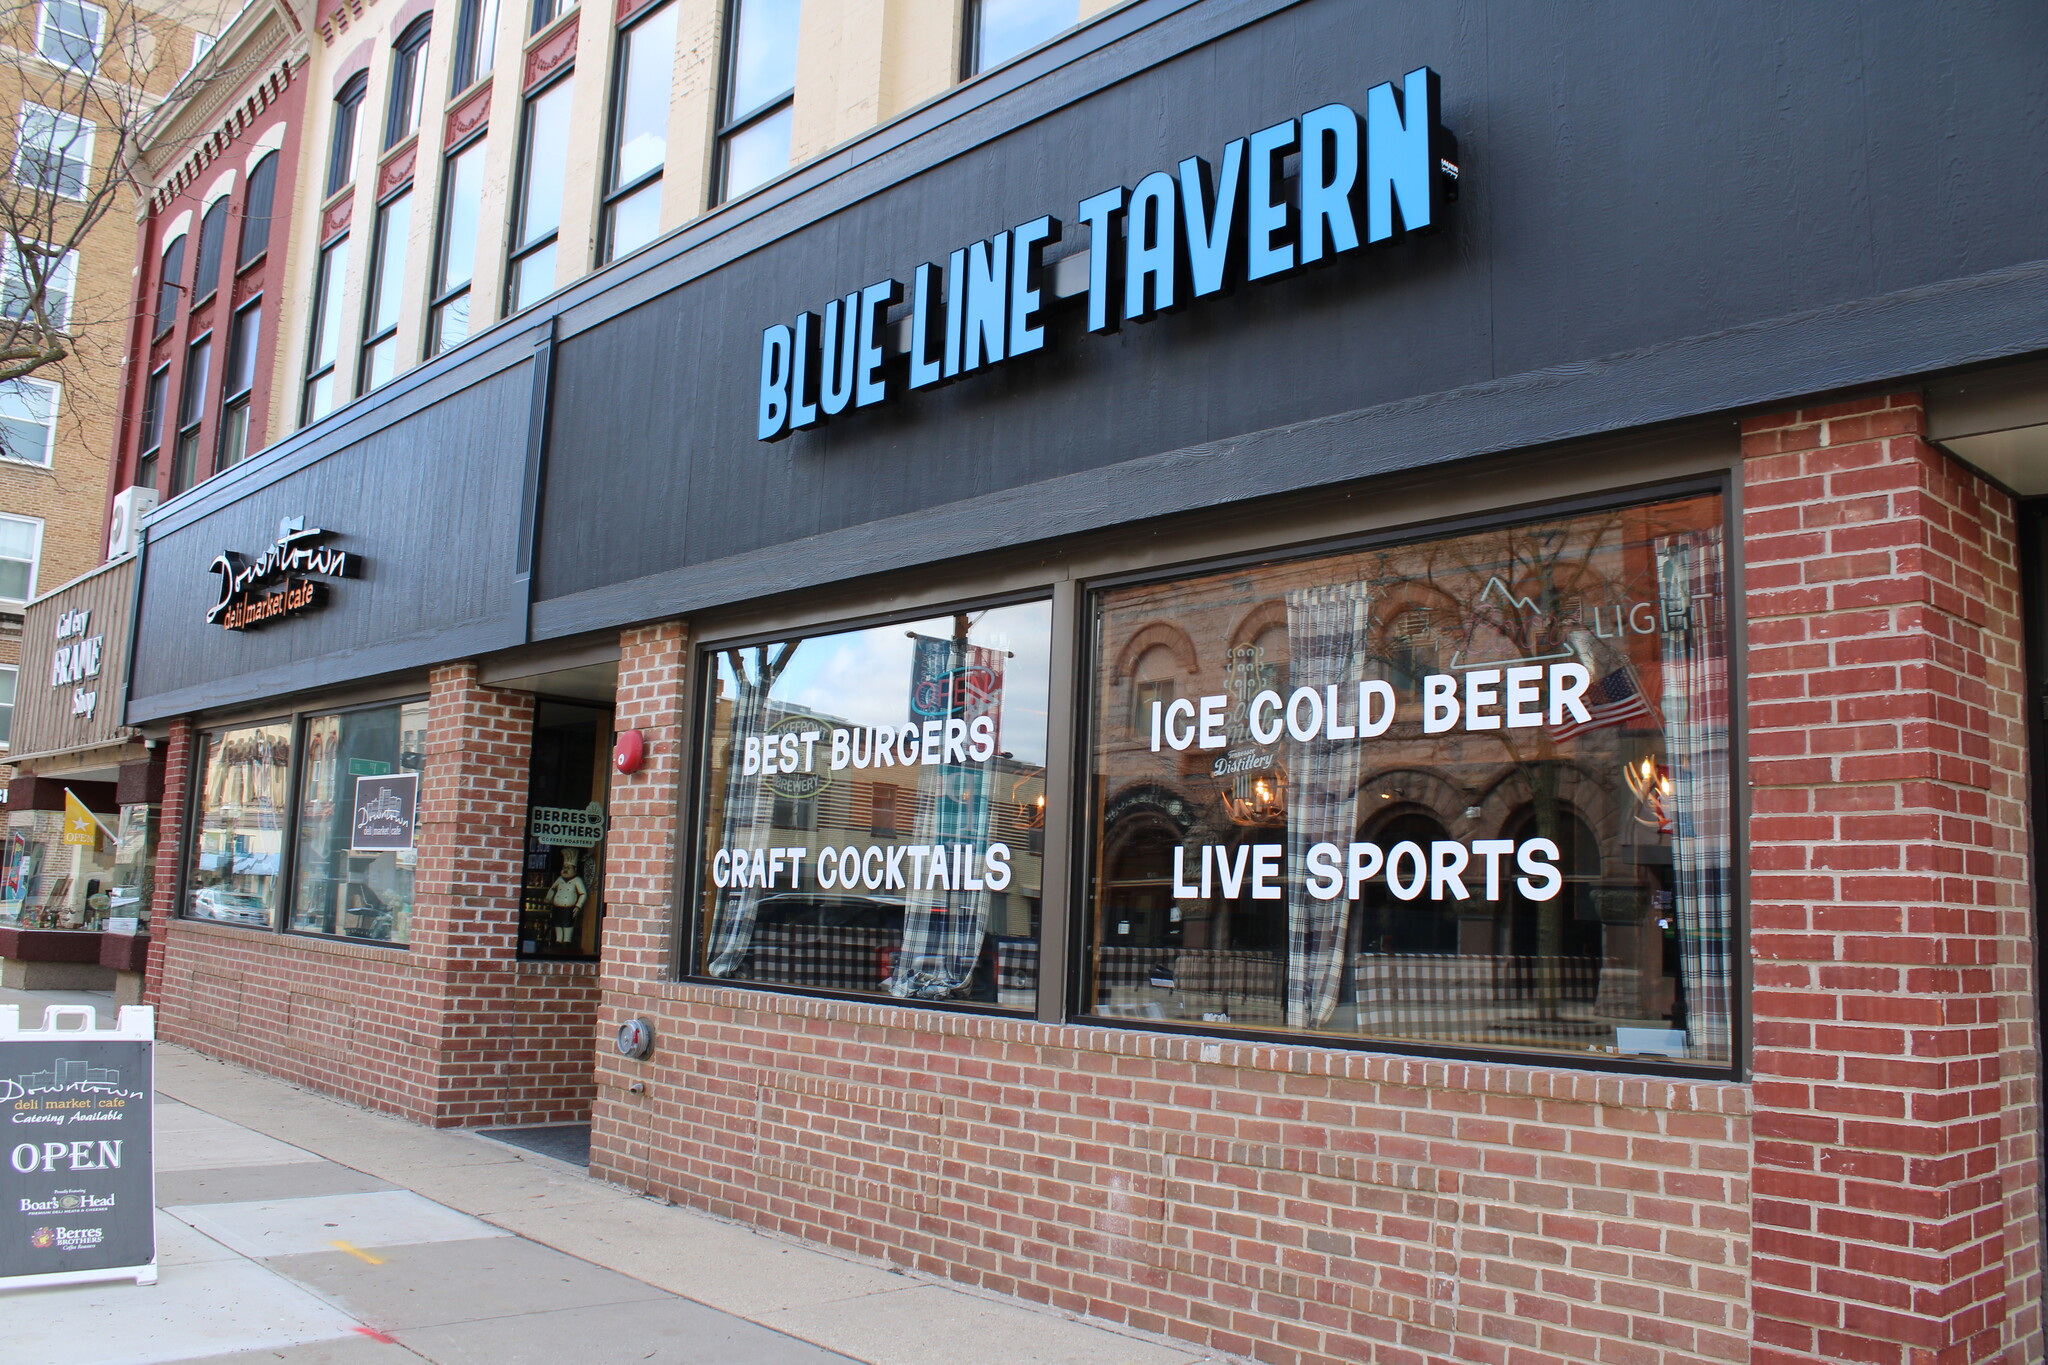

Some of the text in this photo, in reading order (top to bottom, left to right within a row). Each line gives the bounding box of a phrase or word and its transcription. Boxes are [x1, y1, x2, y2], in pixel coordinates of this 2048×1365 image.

[758, 66, 1432, 441] BLUE LINE TAVERN
[206, 528, 346, 624] Downtown
[1594, 593, 1713, 638] LIGHT
[52, 635, 103, 687] FRAME
[915, 673, 991, 709] OPEN
[1150, 695, 1228, 753] ICE
[1249, 680, 1396, 744] COLD
[1424, 663, 1592, 734] BEER
[743, 715, 995, 776] BEST BURGERS
[1213, 754, 1273, 776] Distillery
[775, 775, 819, 792] BREWERY
[358, 806, 409, 829] Downtown
[534, 809, 586, 824] BERRES
[66, 832, 94, 843] OPEN
[533, 823, 601, 838] BROTHERS
[713, 842, 1012, 891] CRAFT COCKTAILS
[1173, 838, 1563, 901] LIVE SPORTS
[0, 1079, 143, 1103] Downtown
[14, 1097, 125, 1110] deli market cafe
[12, 1110, 123, 1125] Catering Available
[11, 1140, 123, 1173] OPEN
[19, 1193, 115, 1211] Boar's Head
[56, 1227, 102, 1239] Berres
